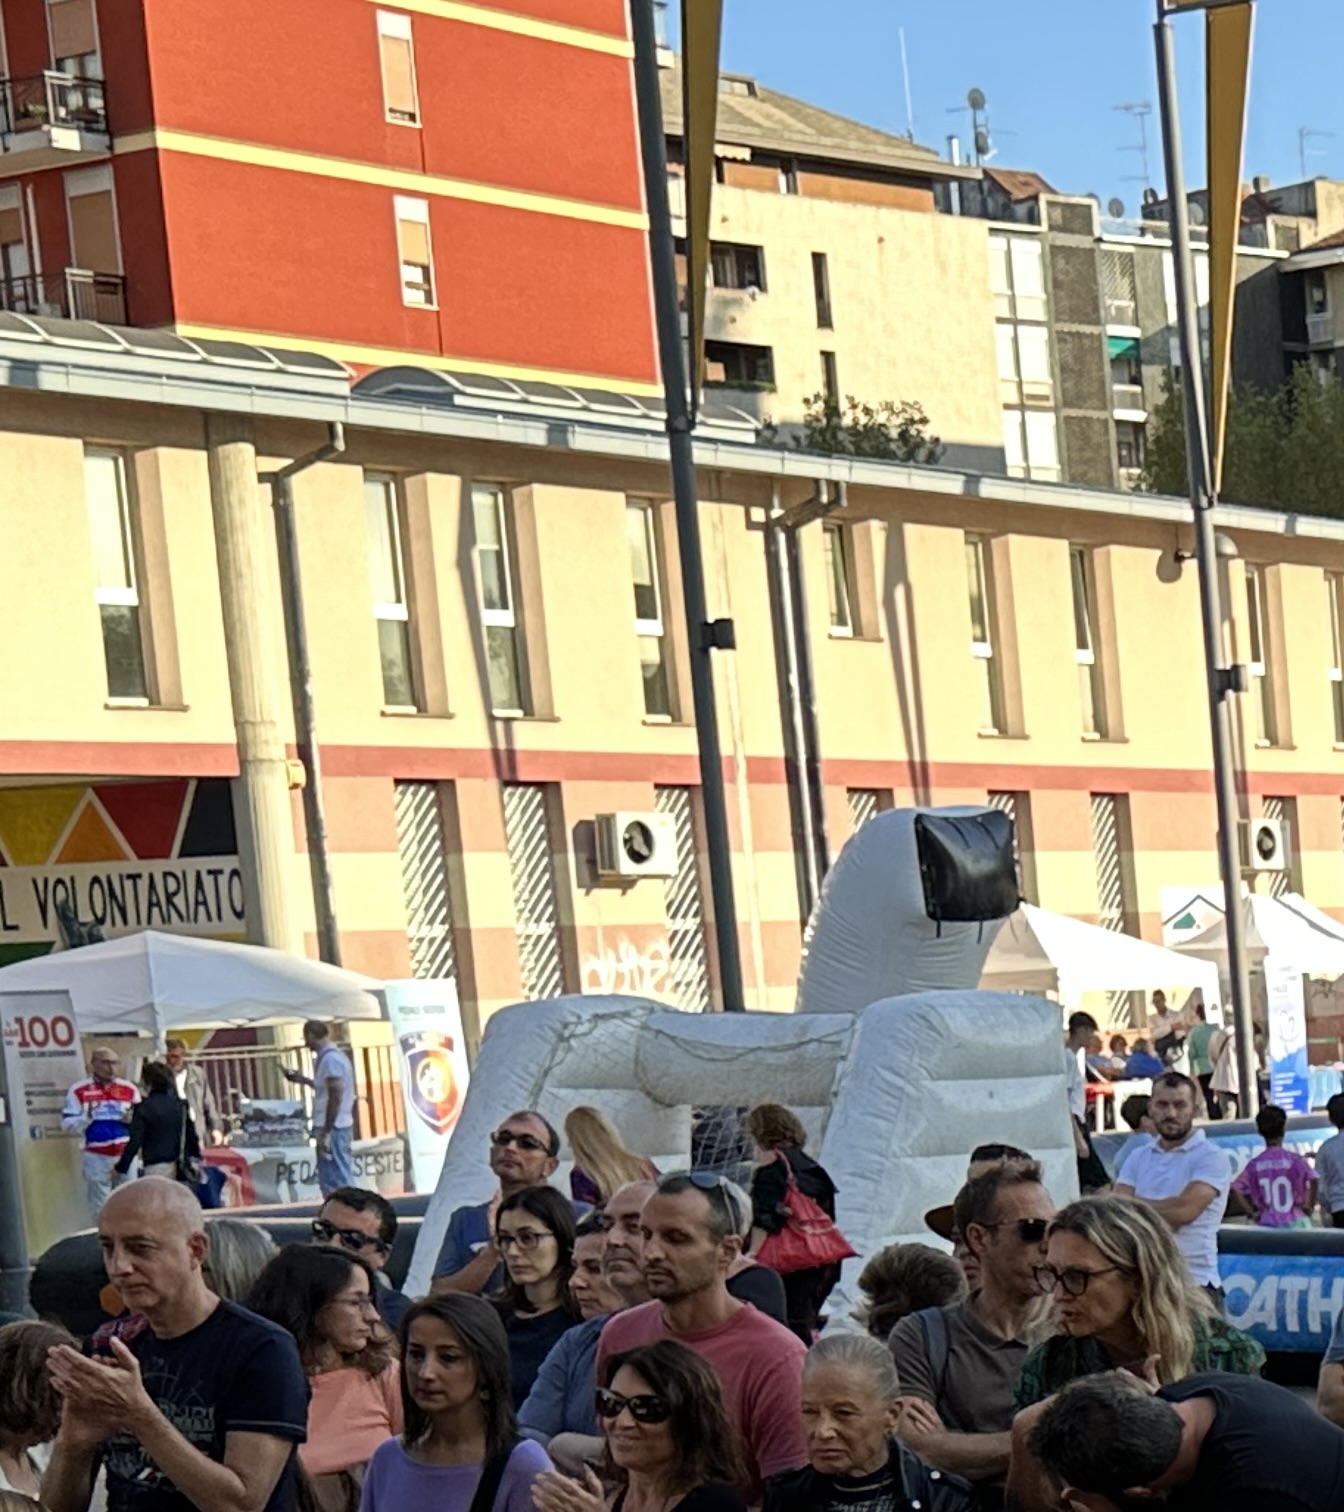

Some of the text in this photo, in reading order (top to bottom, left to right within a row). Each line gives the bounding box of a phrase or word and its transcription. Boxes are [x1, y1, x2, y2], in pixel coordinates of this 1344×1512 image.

[31, 868, 247, 931] VOLONTARIATO
[14, 1015, 75, 1048] 100
[352, 1151, 402, 1177] SESTE
[1259, 1175, 1294, 1214] 10
